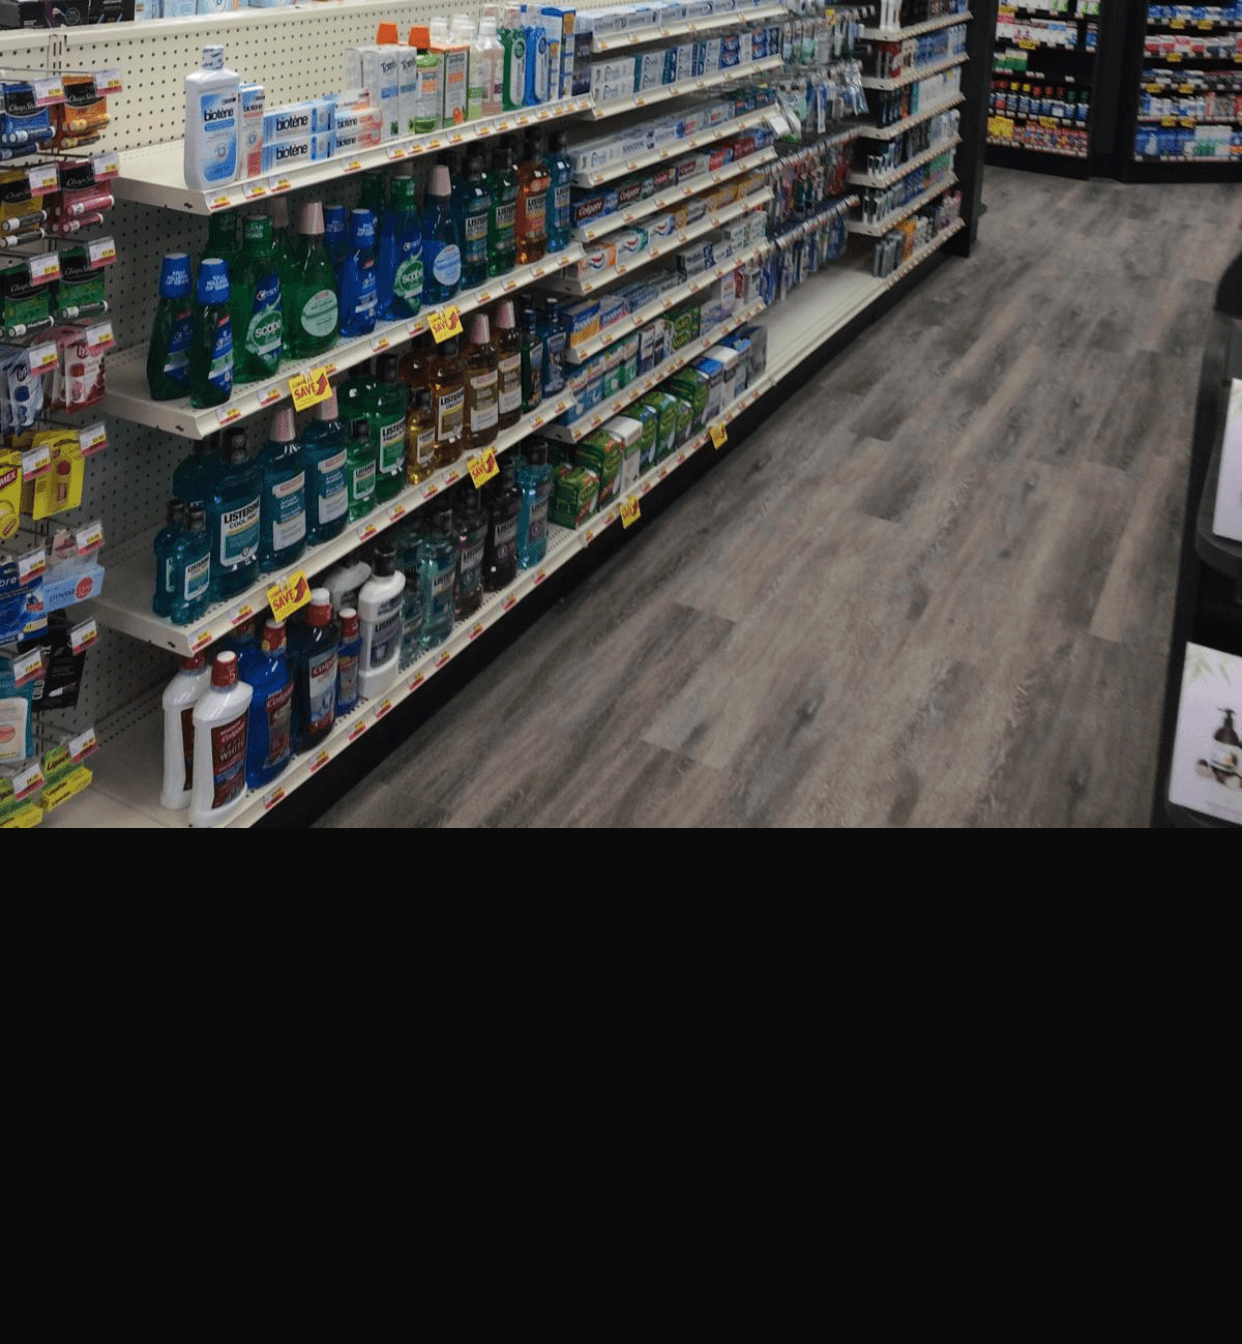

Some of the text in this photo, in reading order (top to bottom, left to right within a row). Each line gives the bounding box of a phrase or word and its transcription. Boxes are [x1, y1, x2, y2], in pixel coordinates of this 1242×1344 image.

[619, 185, 642, 201] Colgate
[577, 200, 604, 217] Colgate
[294, 382, 317, 401] SAVE
[272, 589, 295, 611] SAVE
